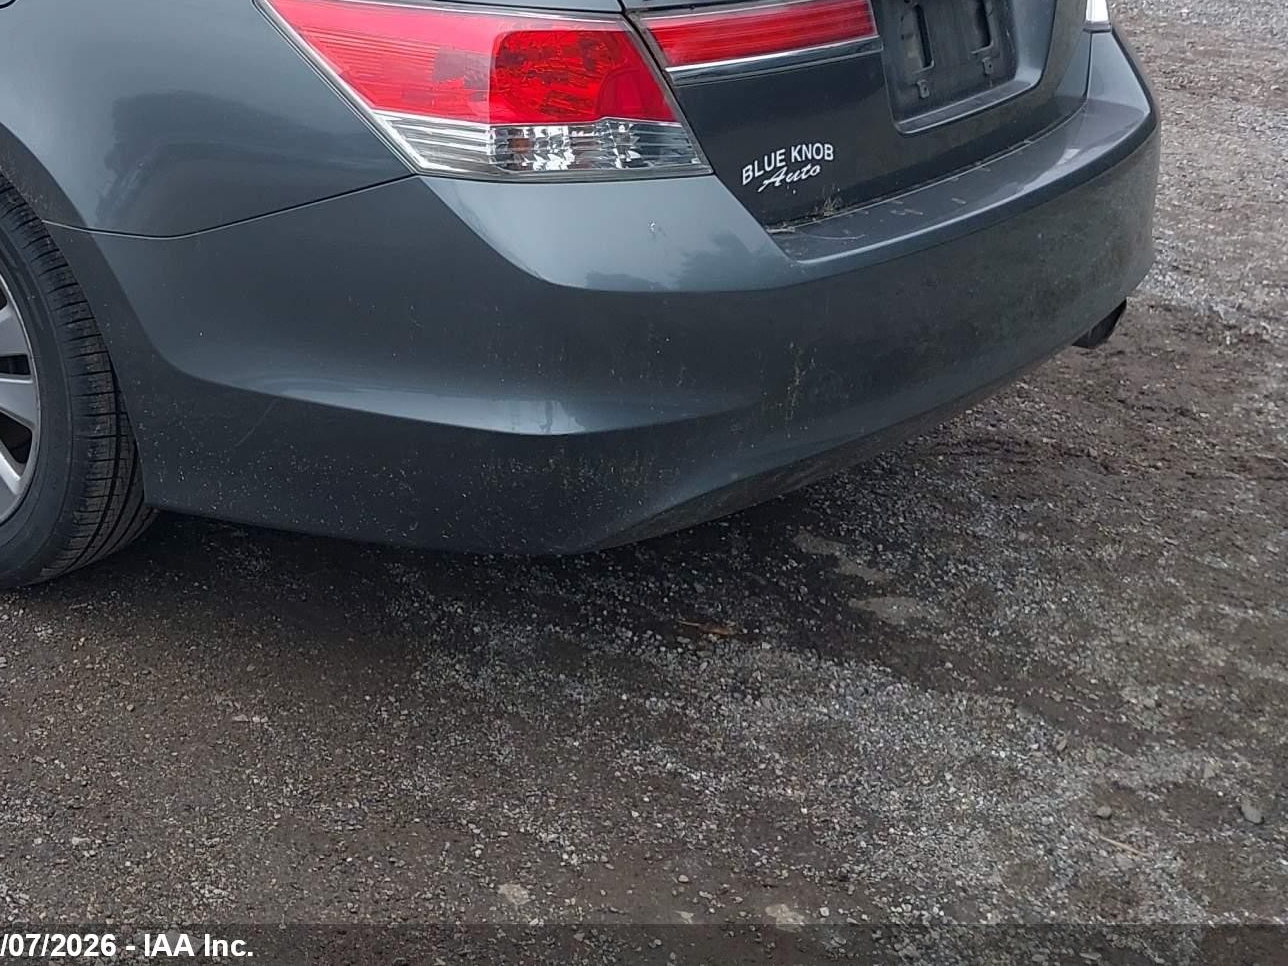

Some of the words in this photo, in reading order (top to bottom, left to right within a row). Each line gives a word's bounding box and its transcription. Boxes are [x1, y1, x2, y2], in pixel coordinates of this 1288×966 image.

[742, 148, 786, 186] BLUE
[791, 142, 834, 163] KNOB
[757, 162, 821, 193] Auto
